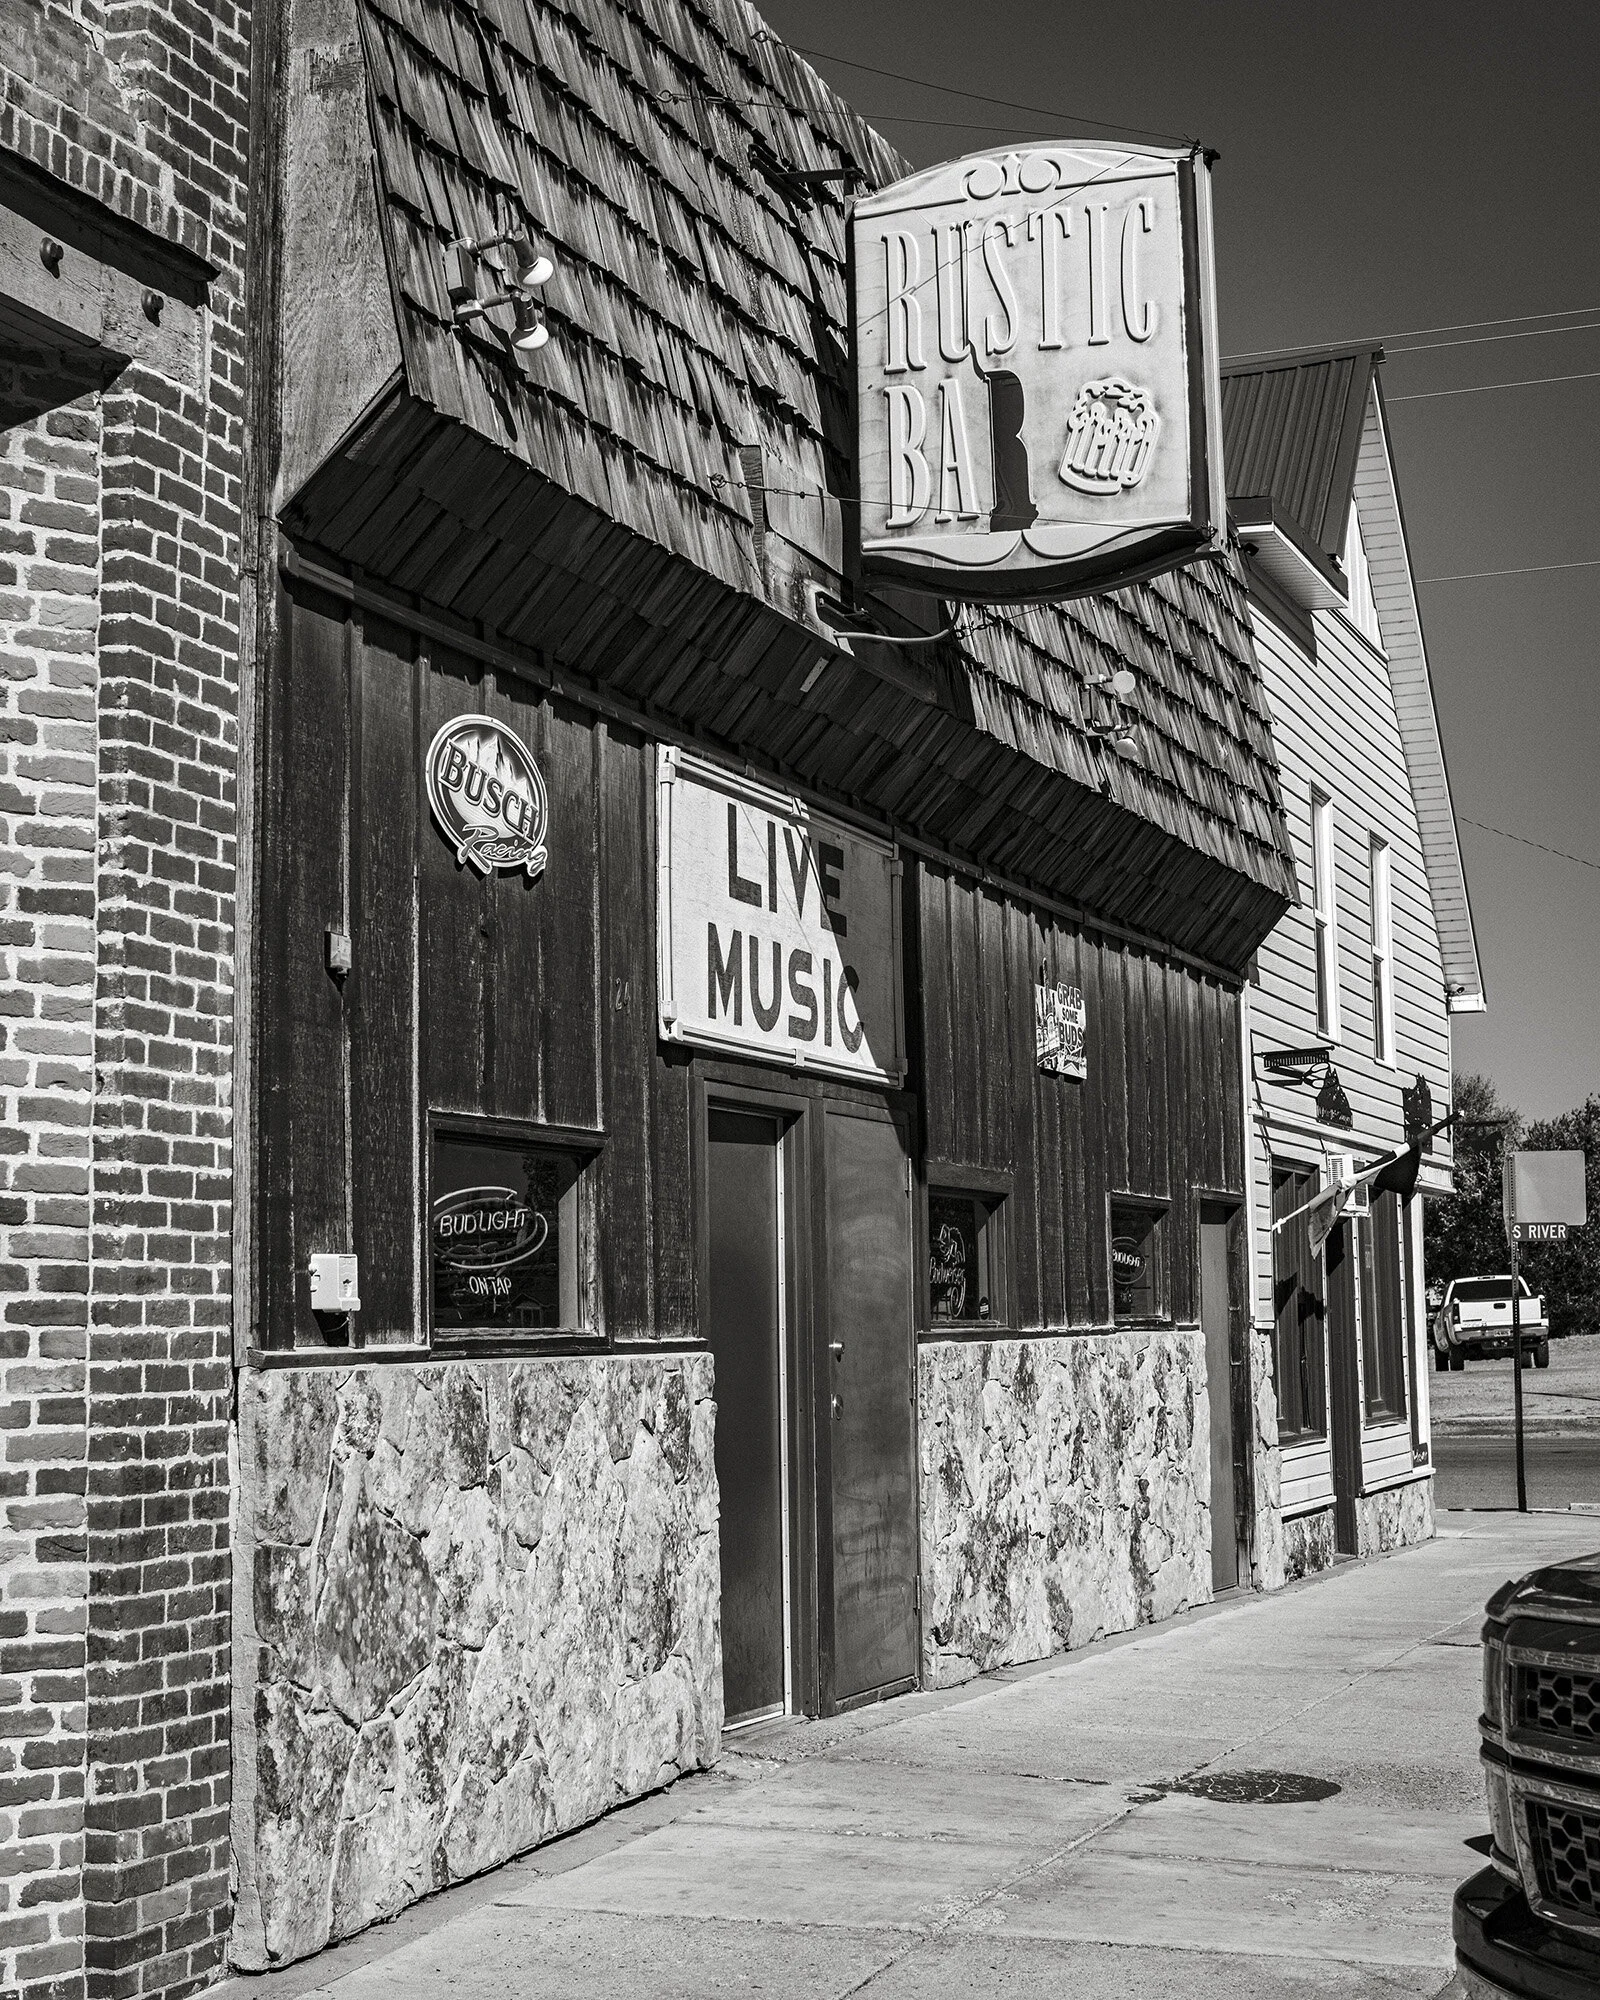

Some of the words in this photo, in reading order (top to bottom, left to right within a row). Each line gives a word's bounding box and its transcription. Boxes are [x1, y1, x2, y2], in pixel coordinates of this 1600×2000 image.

[880, 198, 1157, 374] RUSTIC
[439, 740, 540, 844] BUSCH
[459, 825, 548, 875] Racing
[727, 802, 848, 938] LIVE
[707, 922, 865, 1054] MUSIC
[1057, 982, 1082, 1010] GRAB
[1059, 1021, 1084, 1047] BUDS
[1062, 1007, 1079, 1024] SOME
[1513, 1224, 1522, 1239] S
[1528, 1224, 1567, 1239] RIVER
